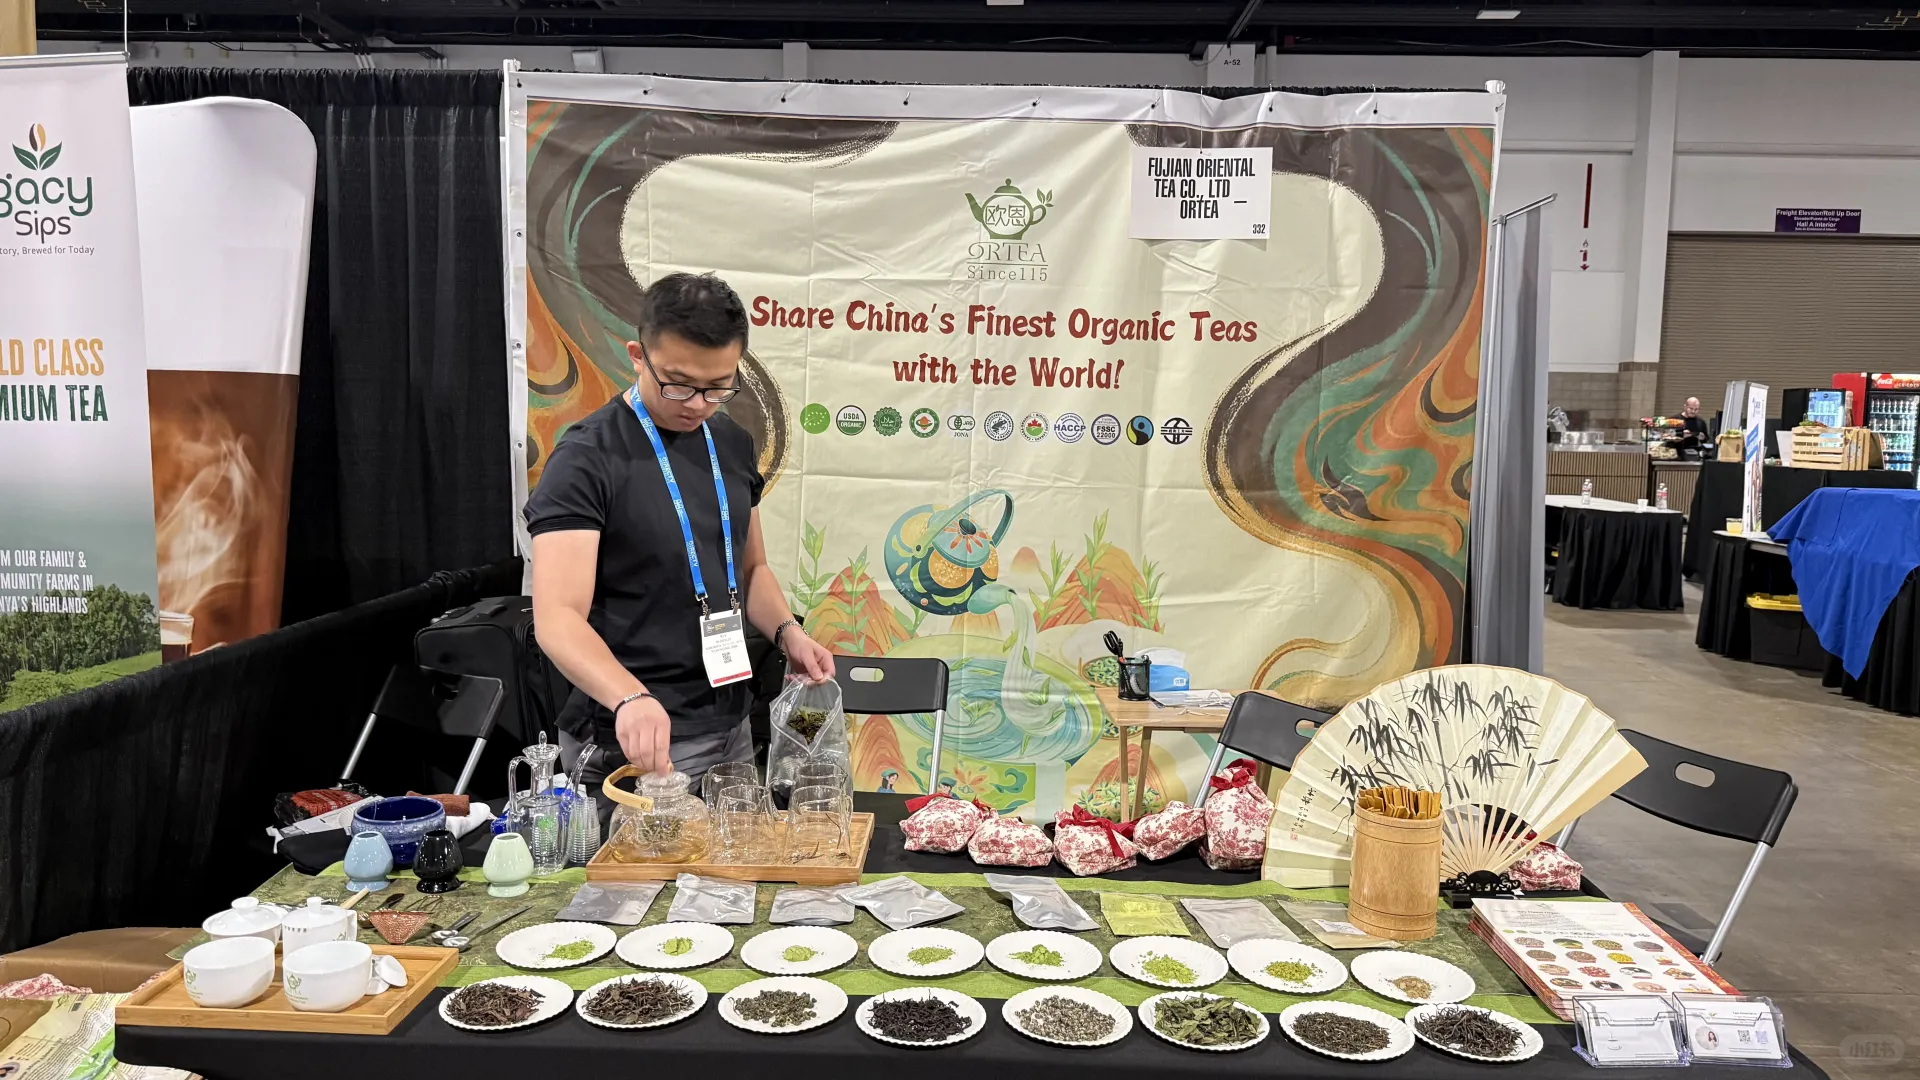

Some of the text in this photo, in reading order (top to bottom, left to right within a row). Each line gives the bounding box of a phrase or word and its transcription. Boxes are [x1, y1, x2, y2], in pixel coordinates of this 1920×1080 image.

[1148, 158, 1256, 177] FUJIAN ORIENTAL
[1154, 178, 1176, 198] TEA
[1180, 178, 1204, 200] CO.,
[1208, 178, 1230, 198] LTD
[986, 204, 1027, 227] 欧恩
[1180, 200, 1219, 219] ORTEA
[14, 210, 72, 244] Sips
[1252, 224, 1266, 234] 332
[22, 246, 52, 254] Brewed
[54, 246, 66, 254] for
[68, 245, 94, 256] Today
[965, 241, 1046, 262] ORTEA
[750, 296, 1258, 345] Share China's Finest Organic Teas
[34, 338, 104, 376] CLASS
[892, 352, 1124, 389] with the World!
[65, 384, 108, 422] TEA
[14, 550, 37, 567] OUR
[40, 550, 74, 568] FAMILY
[78, 551, 87, 568] &
[0, 572, 94, 592] MUNITY FARMS IN
[32, 596, 88, 614] HIGHLANDS
